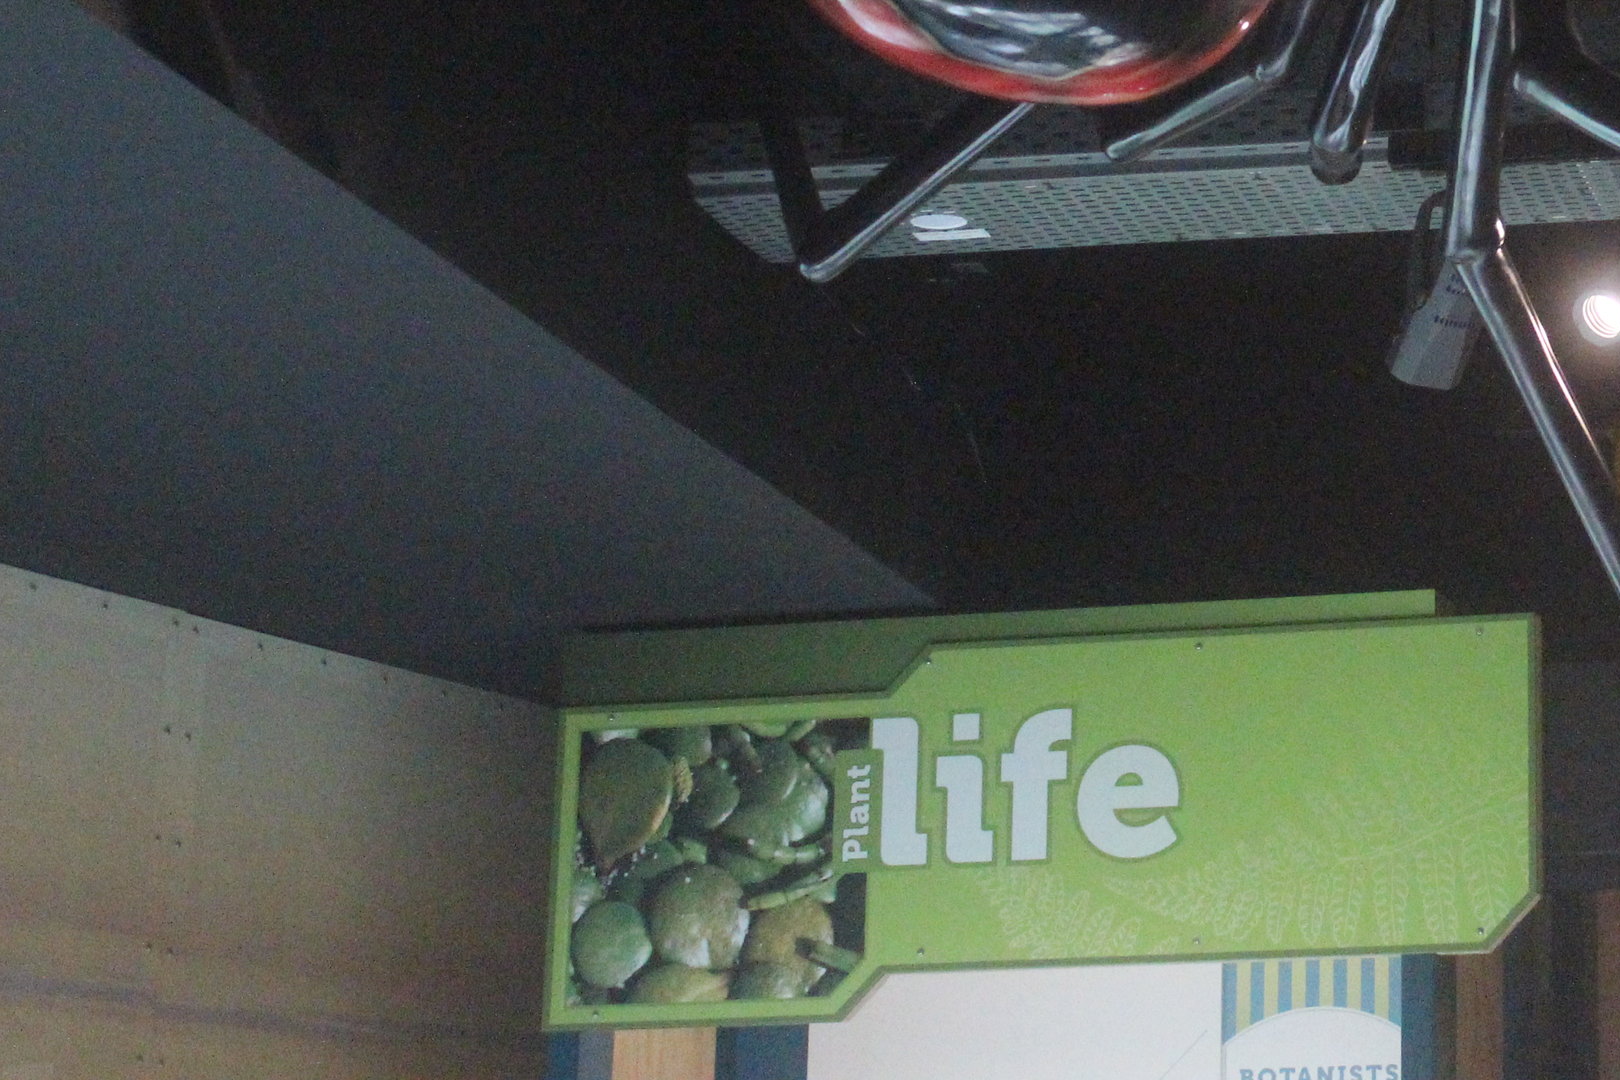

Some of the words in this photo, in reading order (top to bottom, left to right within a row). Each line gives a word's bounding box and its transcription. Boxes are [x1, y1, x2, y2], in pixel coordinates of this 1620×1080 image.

[841, 763, 873, 863] Plant
[872, 708, 1181, 866] life
[1239, 1064, 1399, 1080] BOTANISTS
